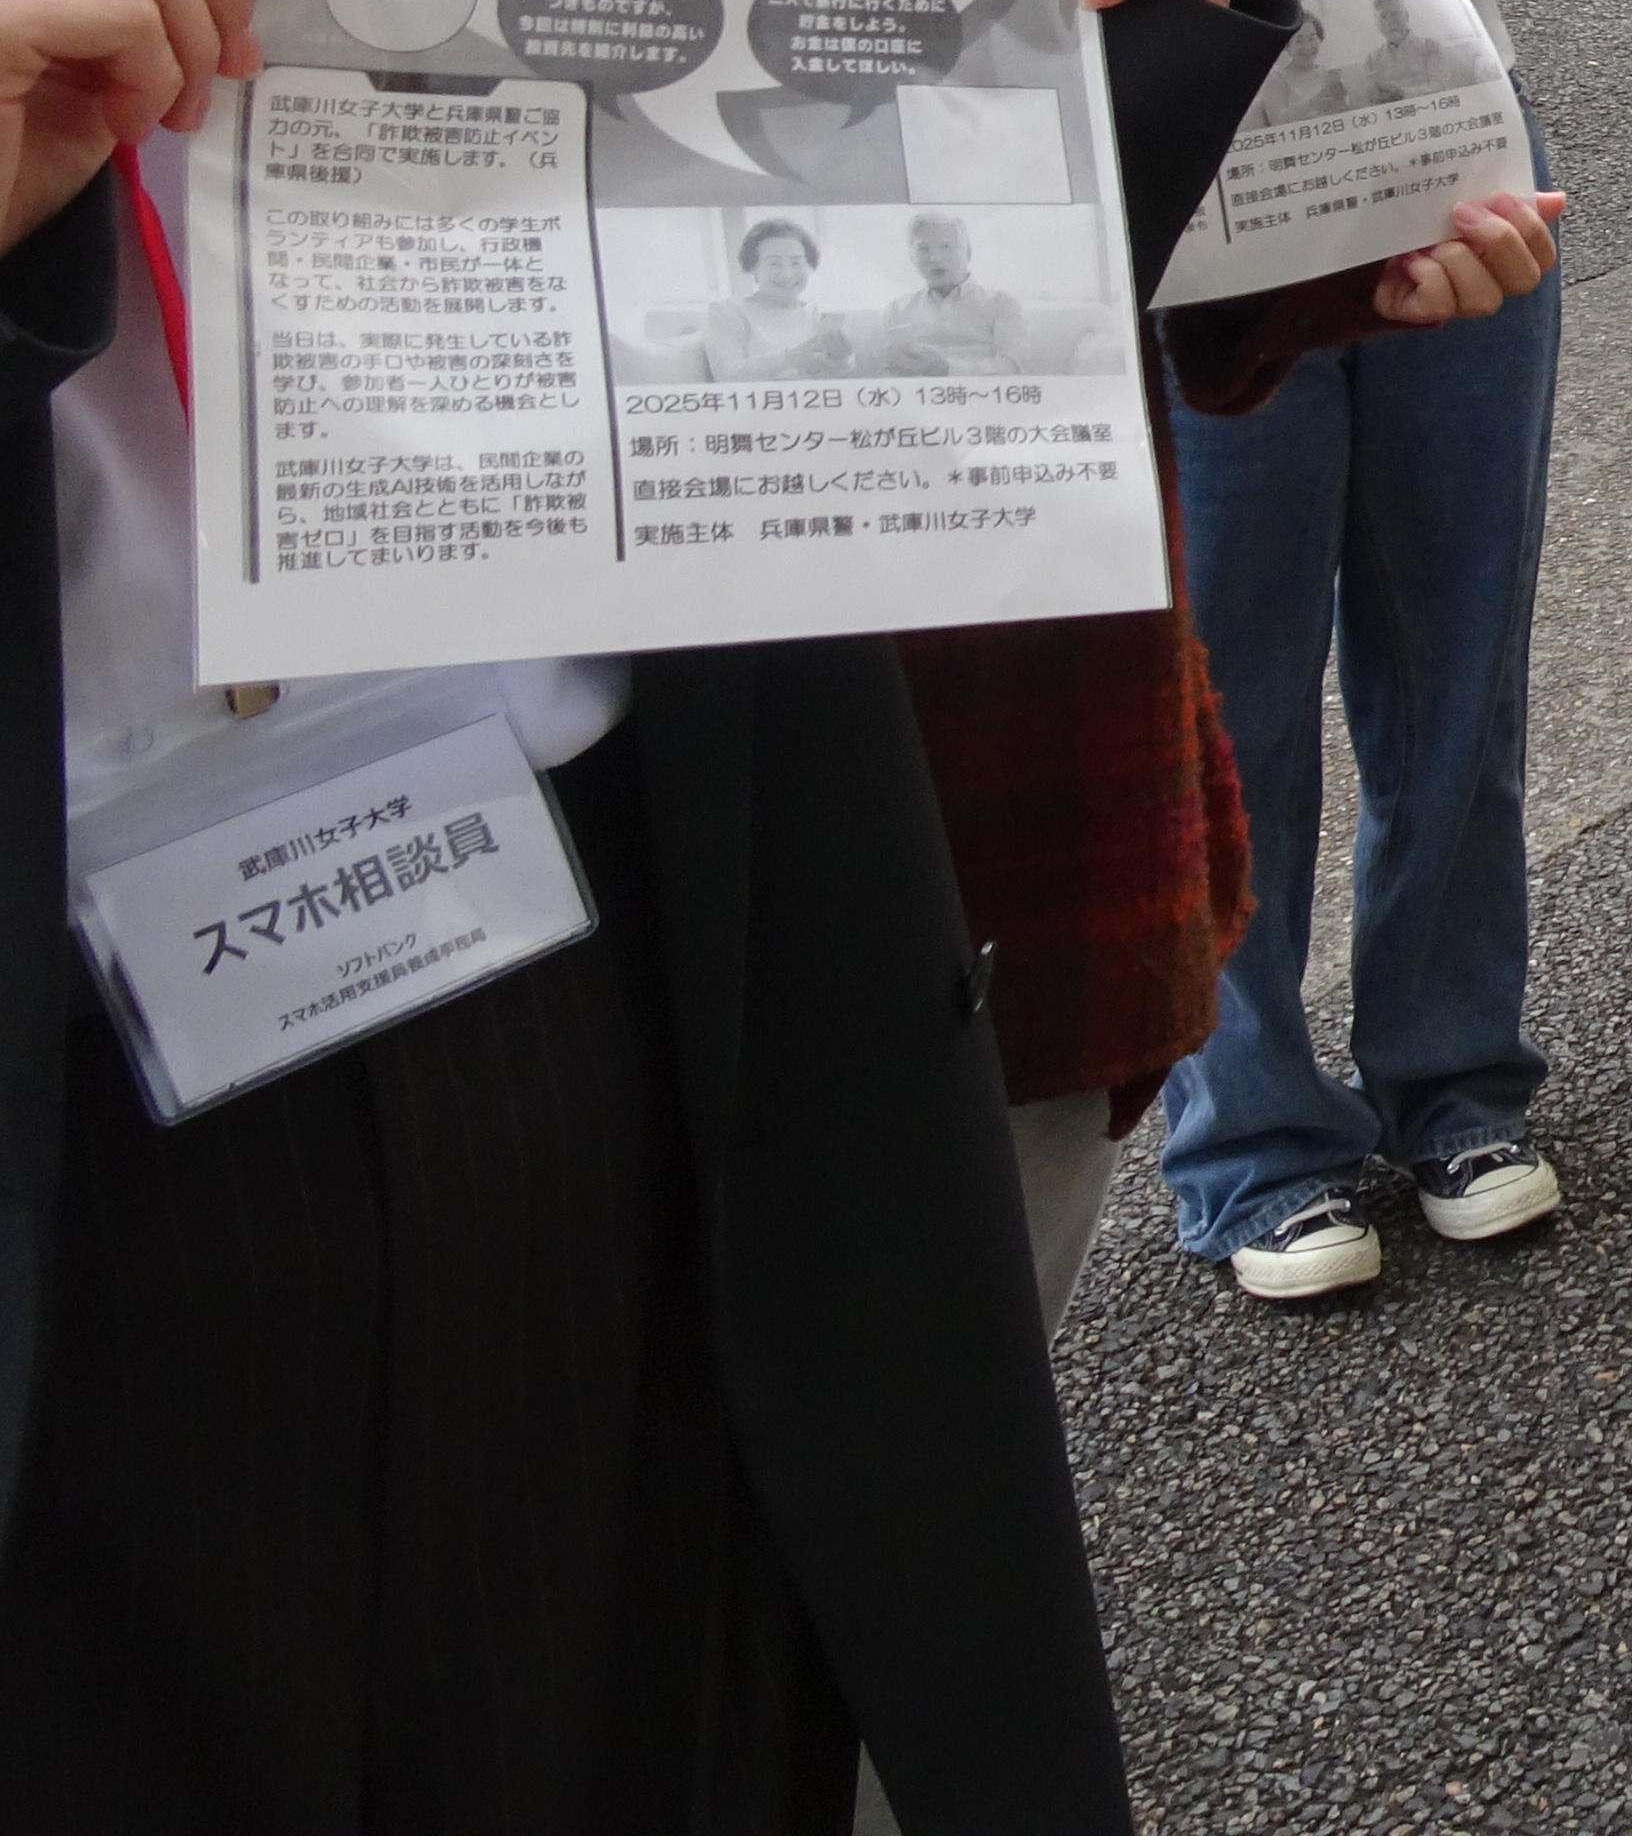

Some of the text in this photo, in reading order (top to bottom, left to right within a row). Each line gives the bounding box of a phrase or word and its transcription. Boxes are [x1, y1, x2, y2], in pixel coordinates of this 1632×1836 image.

[634, 507, 1037, 547] 実施主体 兵庫県警・武庫川女子大学
[238, 794, 413, 882] 武庫川女子大学
[194, 812, 499, 975] スマホ相談員
[336, 933, 418, 979] ソフトバンク
